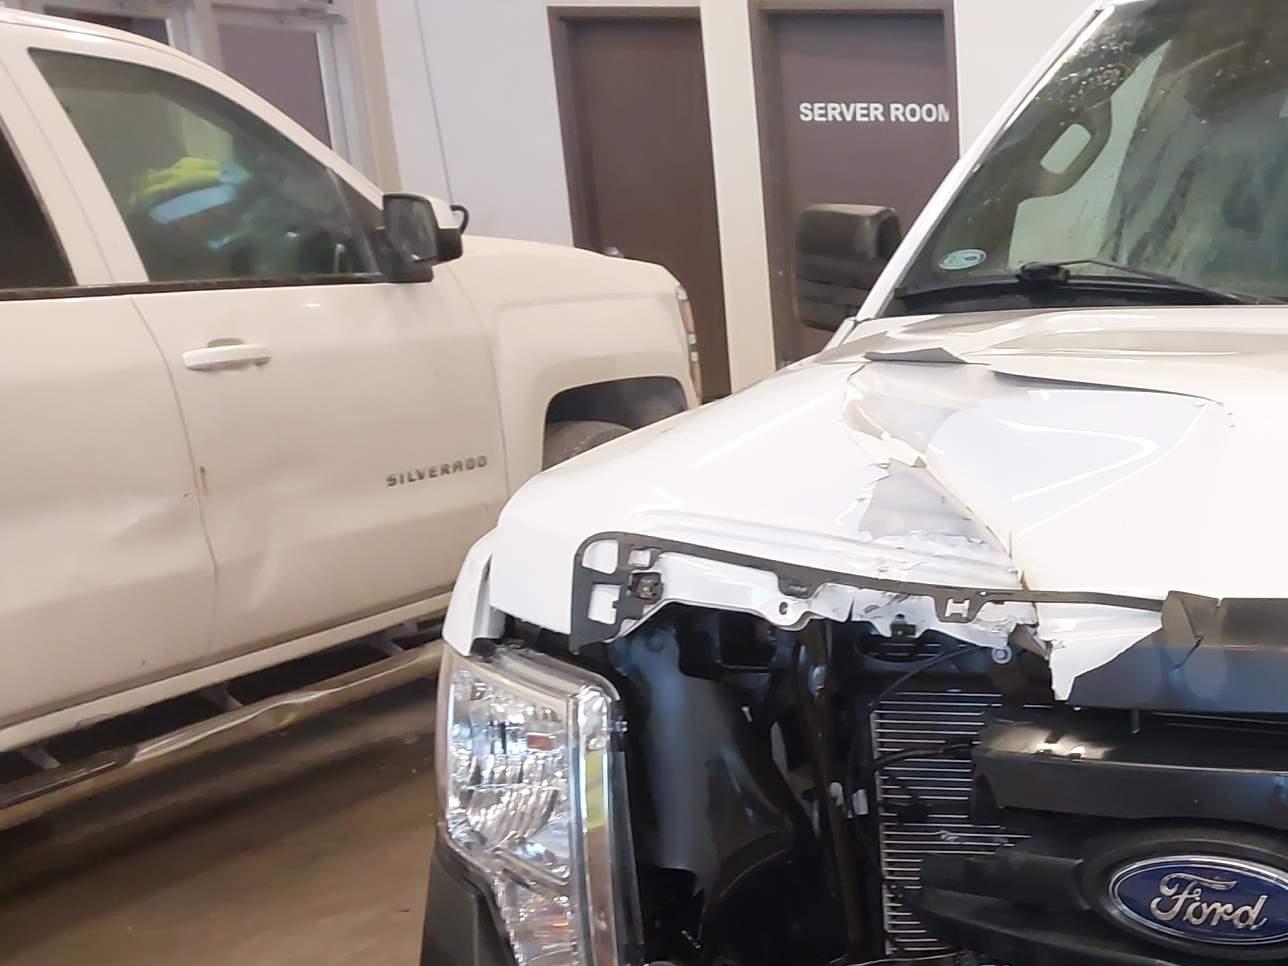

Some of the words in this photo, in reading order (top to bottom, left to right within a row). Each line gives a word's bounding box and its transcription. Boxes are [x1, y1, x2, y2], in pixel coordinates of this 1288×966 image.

[799, 102, 885, 122] SERVER
[386, 455, 488, 487] SILVERADO
[1150, 872, 1268, 930] Ford
